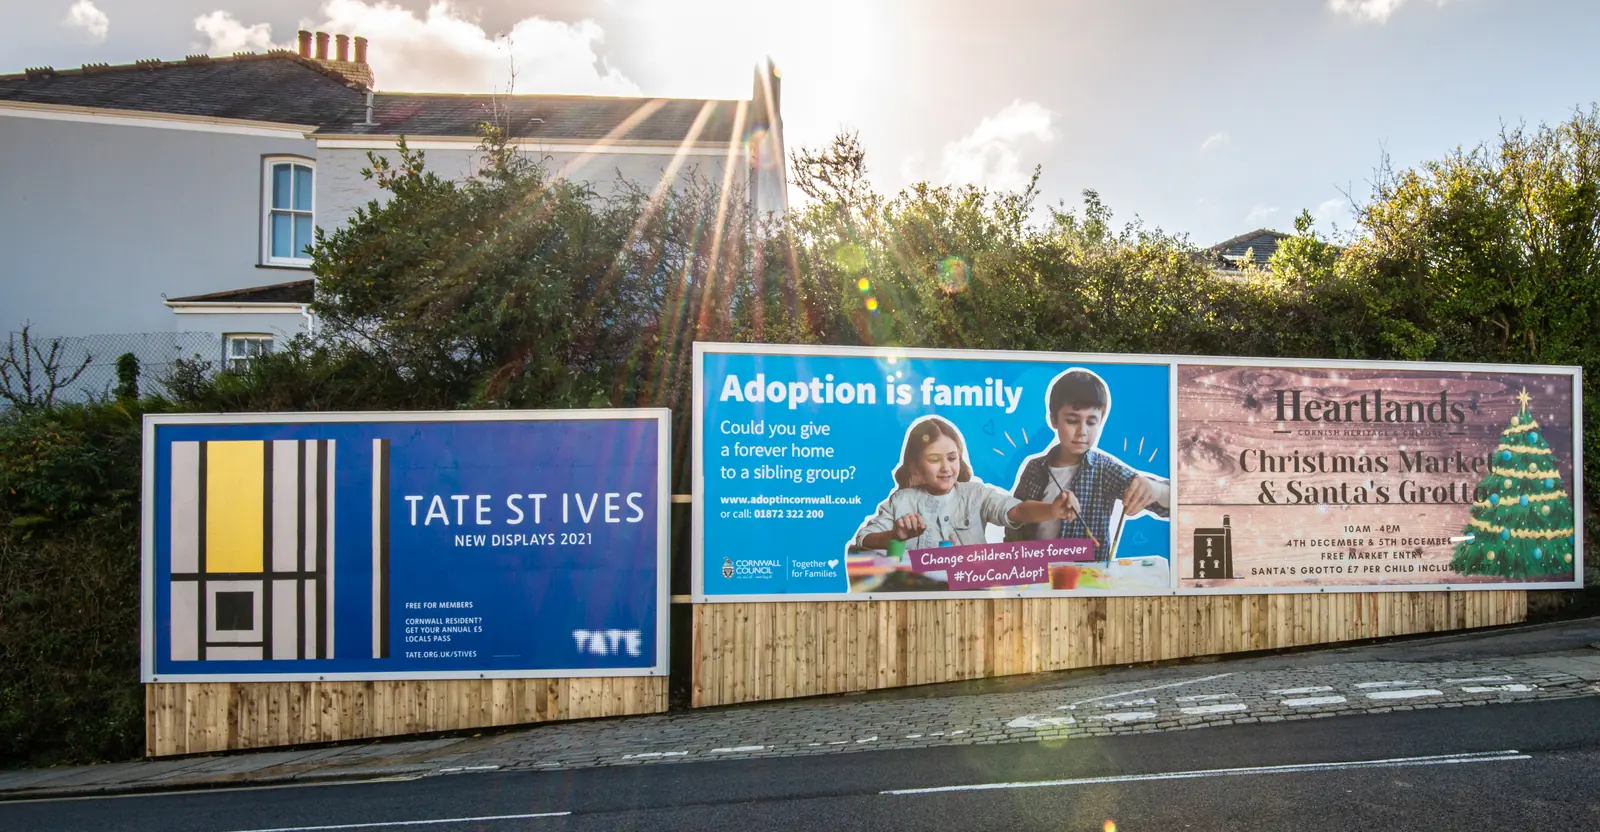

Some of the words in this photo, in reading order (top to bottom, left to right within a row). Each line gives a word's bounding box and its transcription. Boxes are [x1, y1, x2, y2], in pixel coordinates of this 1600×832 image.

[720, 374, 876, 410] Adoption
[887, 375, 912, 406] is
[920, 377, 1023, 413] family
[1273, 388, 1465, 423] Heartlands
[720, 420, 764, 435] Could
[768, 423, 796, 439] you
[800, 422, 830, 440] give
[720, 445, 730, 457] a
[734, 443, 788, 457] forever
[792, 443, 834, 458] home
[1239, 448, 1389, 474] Christmas
[1399, 450, 1493, 474] Market
[720, 466, 736, 479] to
[741, 468, 750, 479] a
[754, 464, 802, 482] sibling
[806, 466, 856, 484] group?
[720, 495, 862, 505] www.adoptincornwall.co.uk
[1258, 480, 1279, 504] &
[1286, 479, 1390, 504] Santa's
[1399, 480, 1488, 504] Grotto
[404, 494, 492, 526] TATE
[506, 494, 547, 524] ST
[562, 492, 644, 524] IVES
[732, 508, 752, 518] call:
[754, 510, 784, 518] 01872
[786, 510, 804, 518] 322
[806, 510, 824, 518] 200
[455, 534, 486, 547] NEW
[492, 533, 555, 546] DISPLAYS
[561, 533, 592, 545] 2021
[1286, 539, 1306, 547] 4TH
[1311, 539, 1364, 547] DECEMBER
[792, 560, 826, 569] Together
[921, 554, 964, 567] Change
[967, 547, 1019, 562] children's
[1021, 546, 1044, 558] lives
[1046, 544, 1087, 557] forever
[1349, 552, 1388, 560] MARKET
[1393, 551, 1424, 559] ENTRY
[954, 566, 1044, 582] #YouCanAdopt
[1252, 566, 1296, 575] SANTA'S
[1301, 566, 1343, 574] GROTTO
[1348, 566, 1359, 574] £7
[1384, 565, 1414, 573] CHILD
[572, 629, 642, 657] TATE
